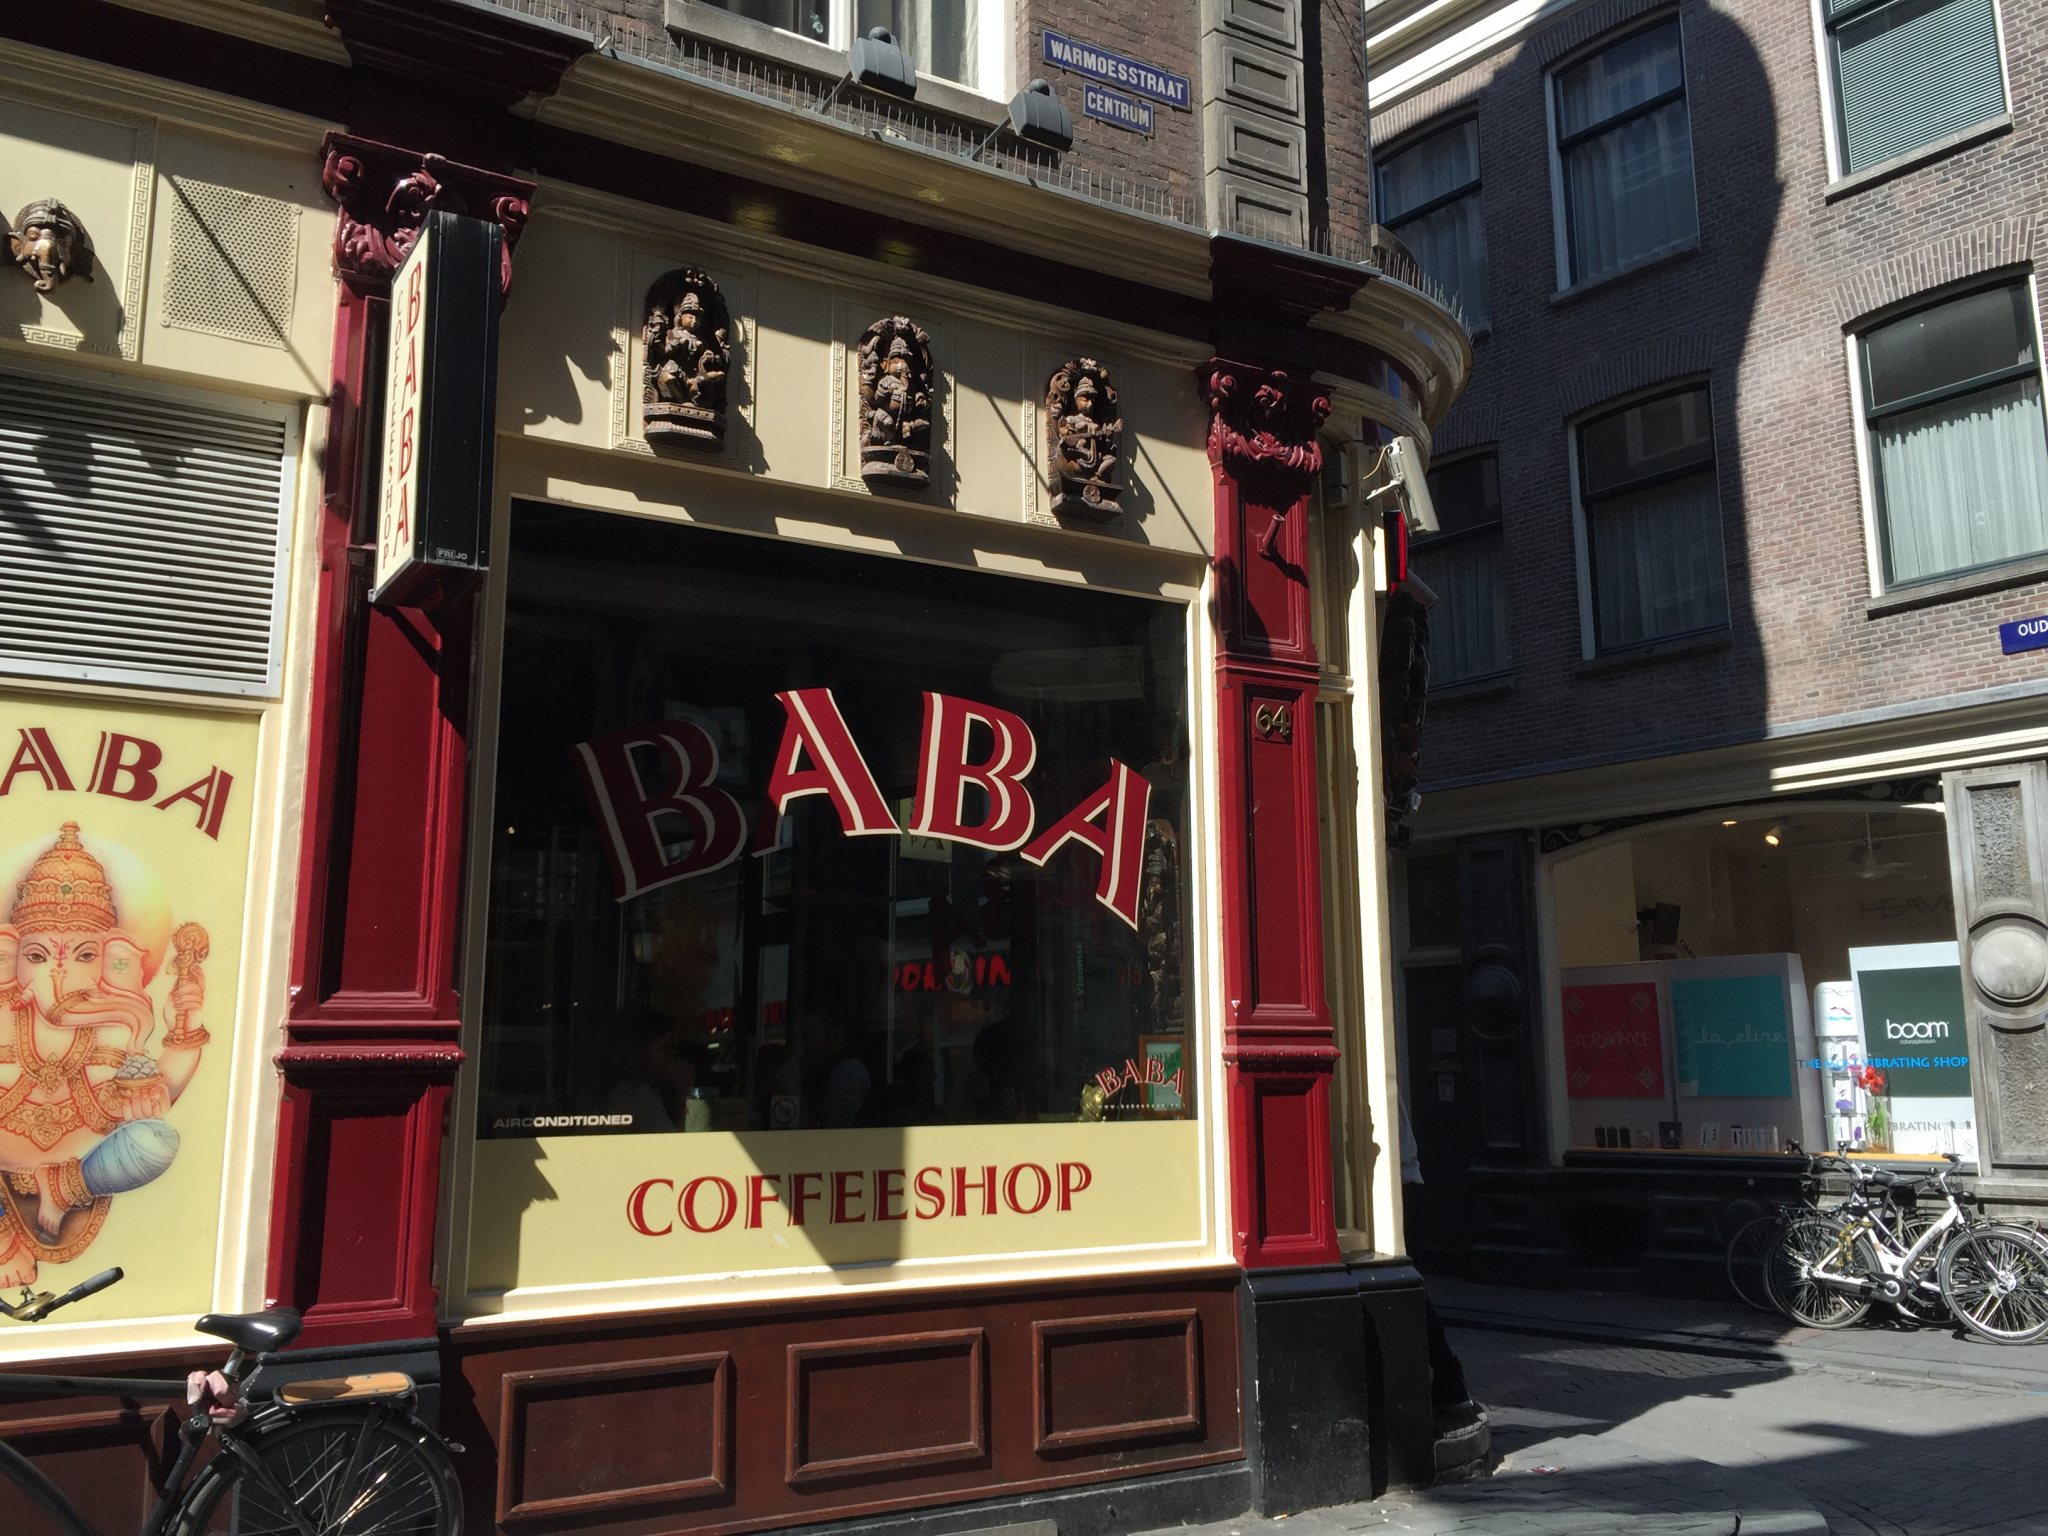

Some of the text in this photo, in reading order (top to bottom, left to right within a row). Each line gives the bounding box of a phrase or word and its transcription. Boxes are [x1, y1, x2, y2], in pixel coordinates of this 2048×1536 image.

[1051, 40, 1184, 100] WARMOESSTRAAT
[1087, 91, 1149, 127] CENTRUM
[393, 261, 422, 558] BABA
[383, 290, 403, 569] COFFEESHOP
[2018, 620, 2048, 636] OUD
[1255, 704, 1290, 736] 64
[568, 687, 1152, 931] BABA
[1886, 1019, 1950, 1040] boom
[1094, 1058, 1185, 1099] BABA
[1797, 1059, 1821, 1069] THE
[1861, 1057, 1930, 1068] VIBRATING
[1932, 1056, 1969, 1068] SHOP
[493, 1114, 634, 1128] AIRCONDITIONED
[627, 1161, 1092, 1237] COFFEESHOP
